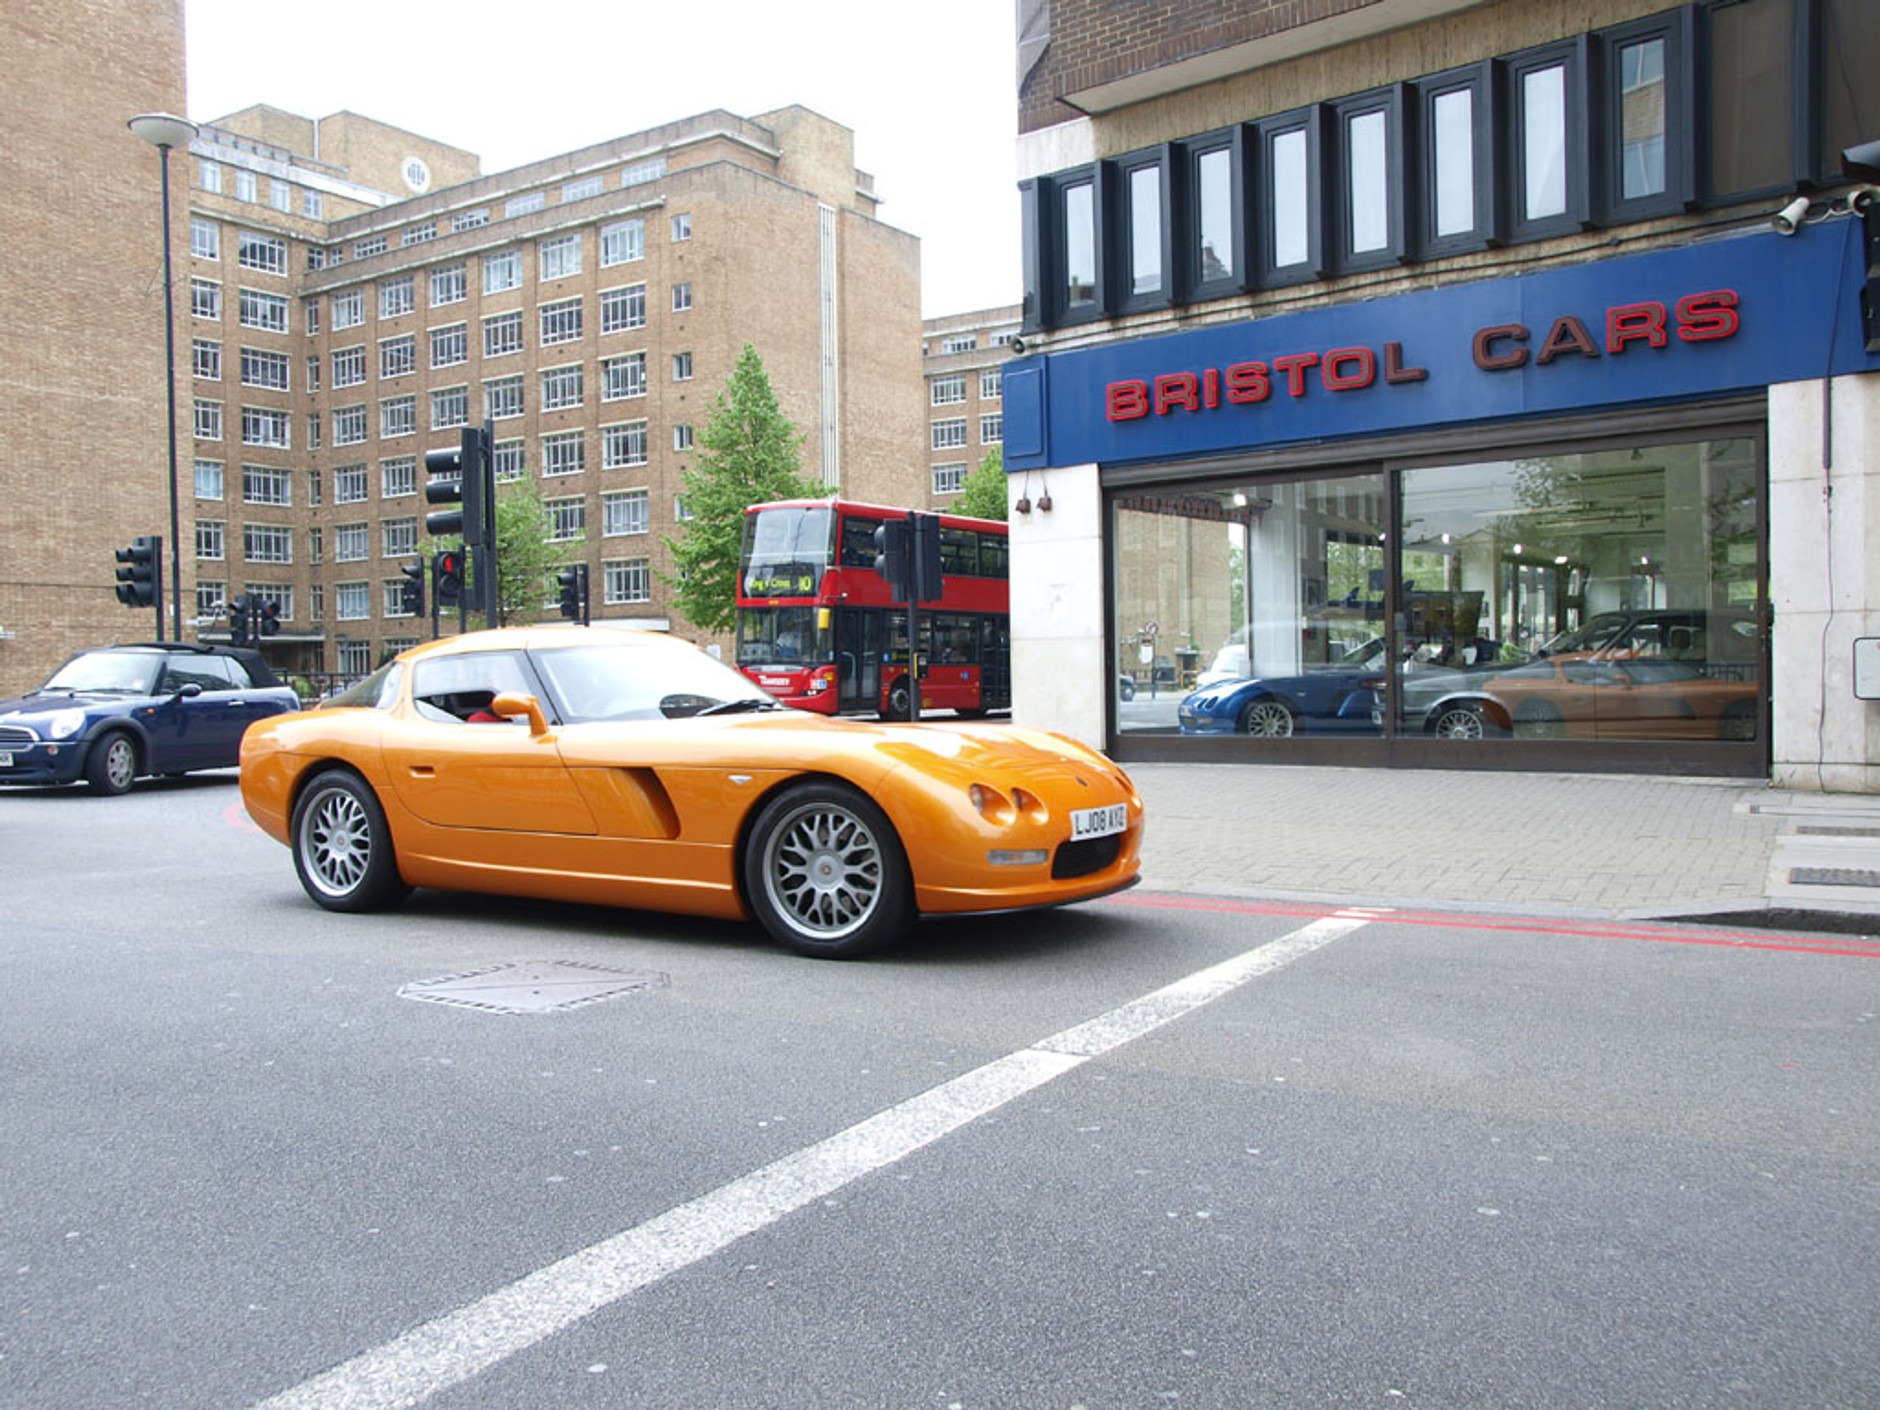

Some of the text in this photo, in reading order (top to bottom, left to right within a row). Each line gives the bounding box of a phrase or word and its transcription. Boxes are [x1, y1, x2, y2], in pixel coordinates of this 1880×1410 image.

[1106, 289, 1739, 422] BRISTOL CARS
[1075, 810, 1106, 835] LJ08
